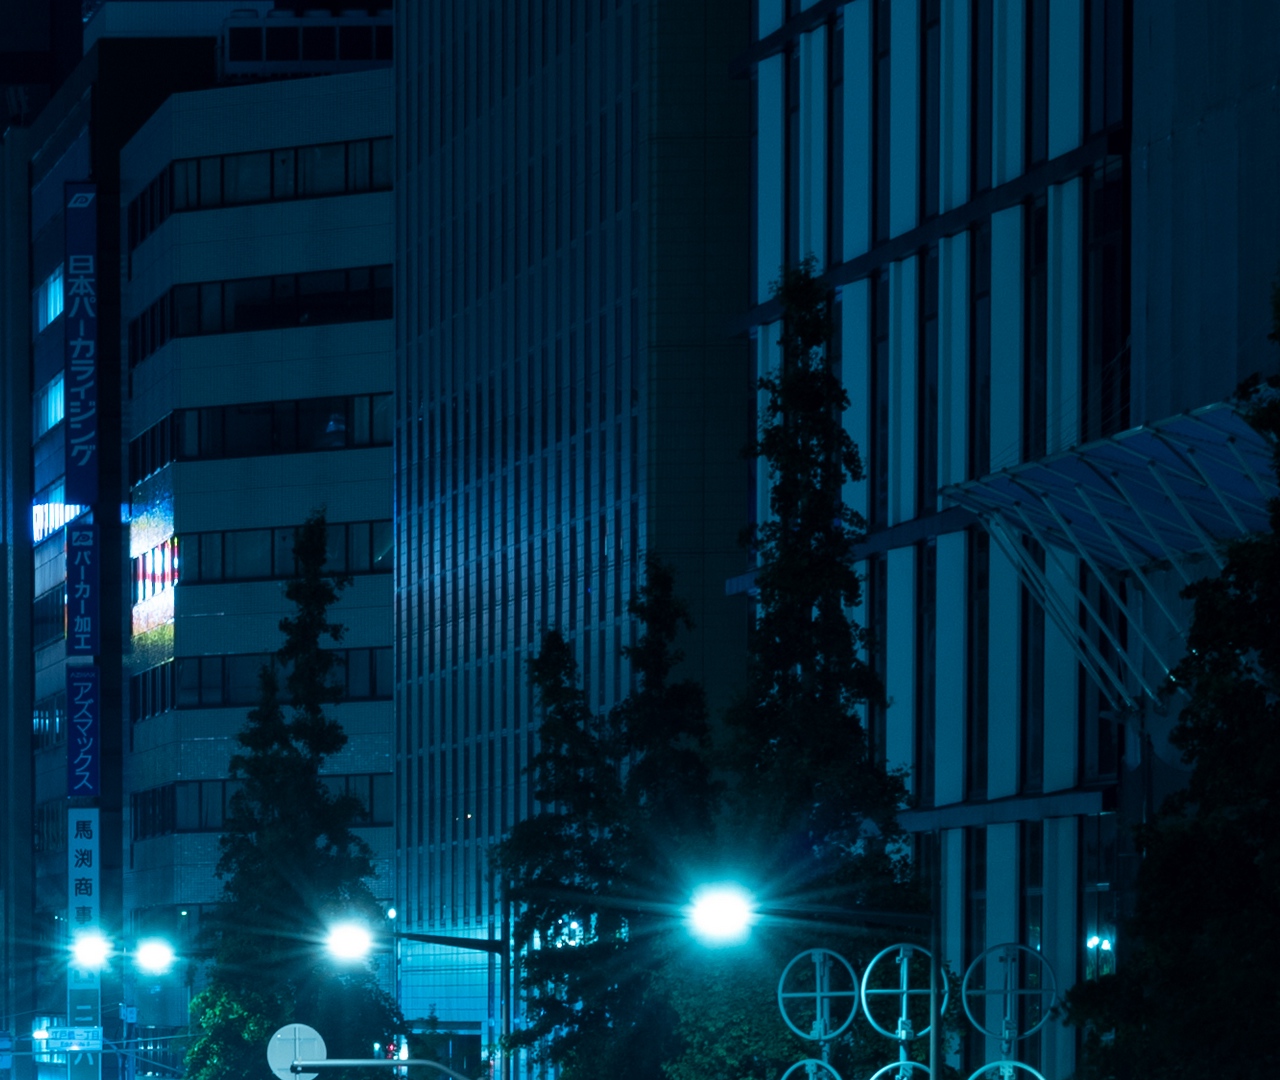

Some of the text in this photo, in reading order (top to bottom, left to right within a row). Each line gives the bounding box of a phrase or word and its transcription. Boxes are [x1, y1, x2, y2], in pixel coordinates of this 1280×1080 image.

[67, 254, 96, 467] 日本パーカライジング
[73, 551, 92, 651] パーカー加工
[72, 682, 93, 790] アズマックス
